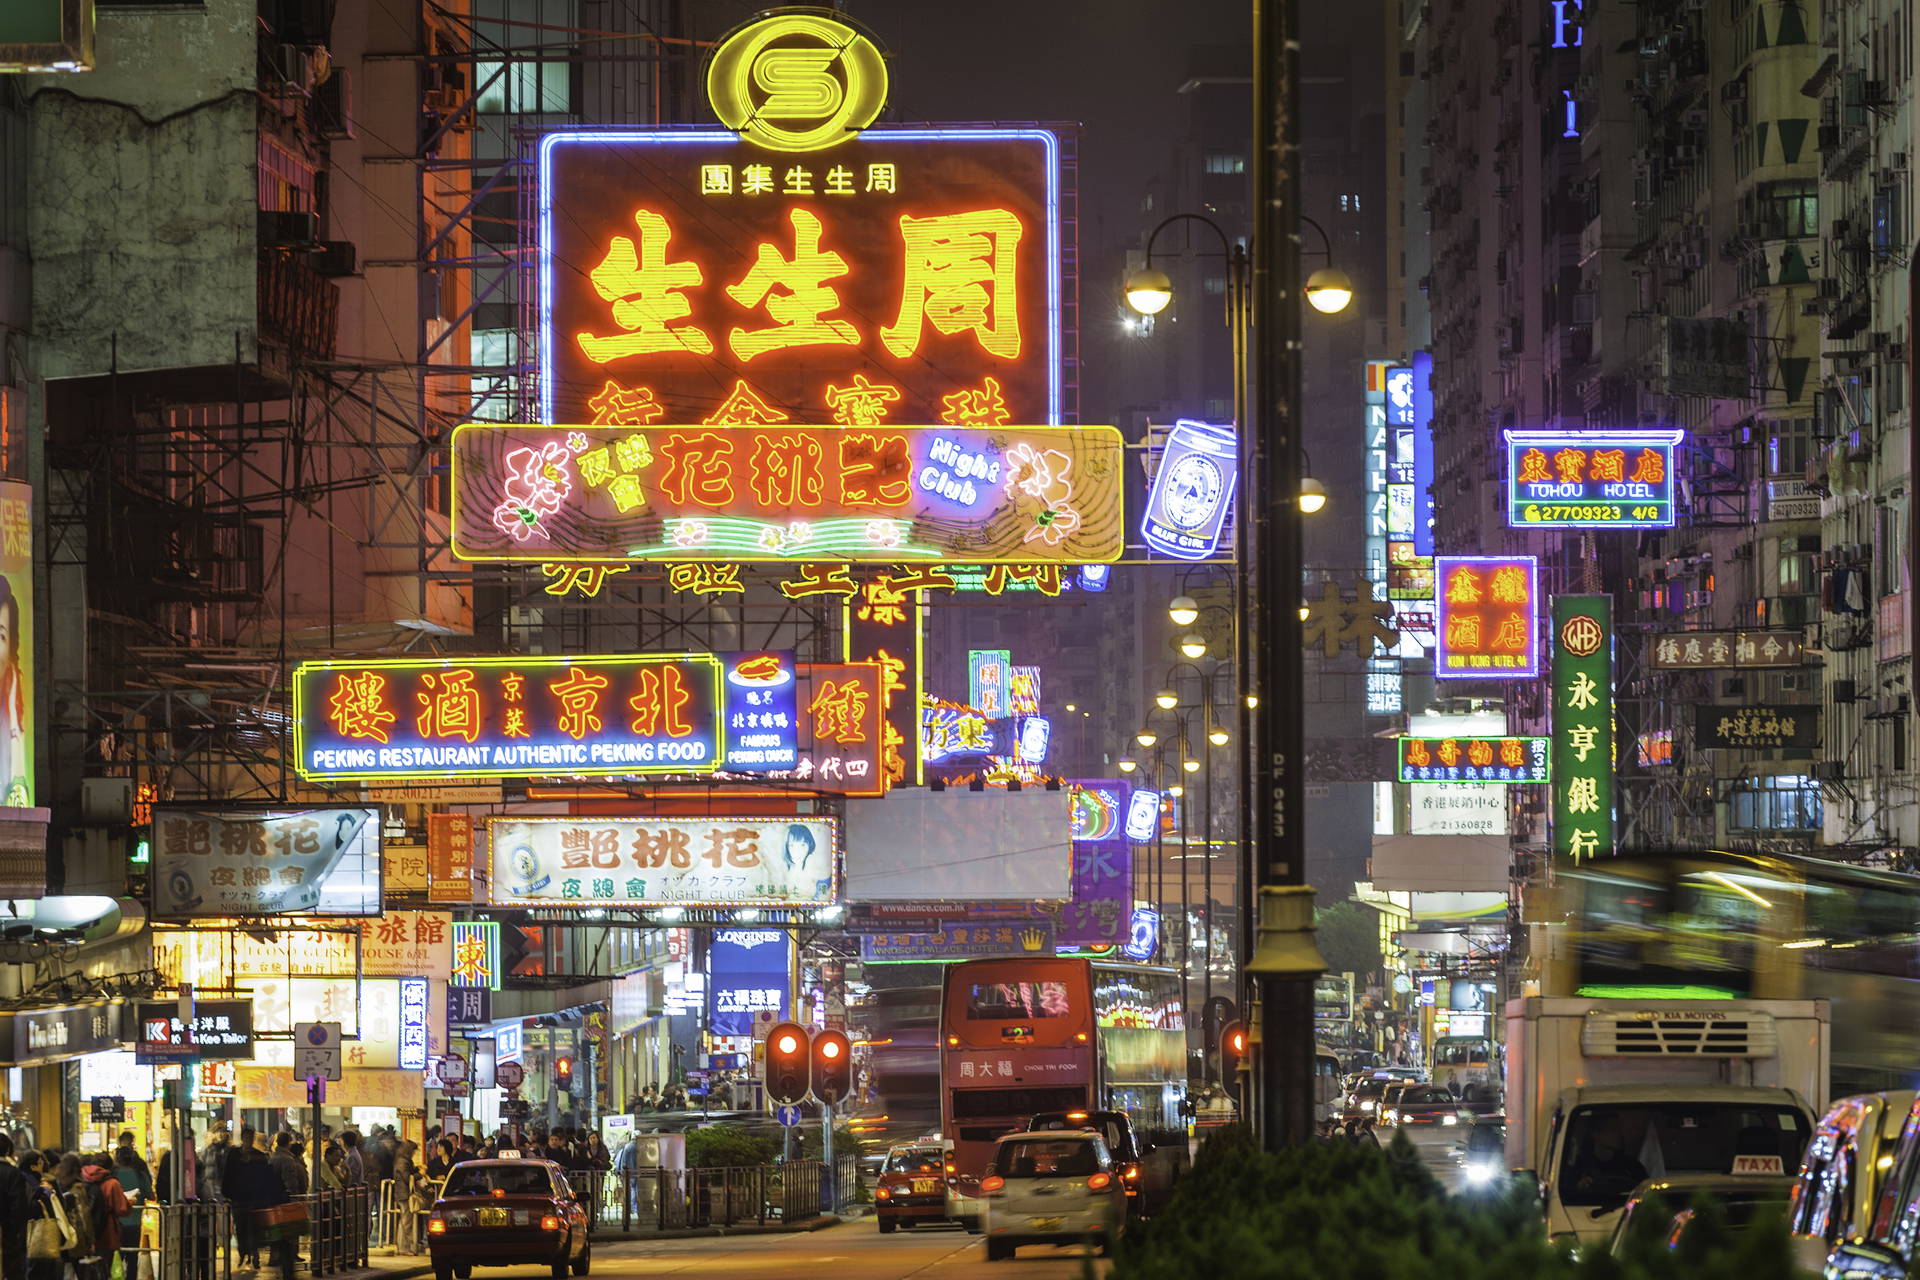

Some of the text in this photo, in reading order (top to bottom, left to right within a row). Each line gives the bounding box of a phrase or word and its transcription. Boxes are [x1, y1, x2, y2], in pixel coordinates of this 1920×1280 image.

[929, 437, 1001, 485] Night
[1518, 448, 1665, 483] 東寶酒店
[919, 466, 978, 506] Club
[1528, 483, 1655, 498] TOHOU HOTEL
[1541, 506, 1622, 520] 27709323
[1152, 525, 1206, 550] BLUE GIRL
[740, 733, 781, 747] FAMOUS
[313, 741, 706, 769] PEKING RESTAURANT AUTHENTIC PEKING FOOD
[1567, 672, 1600, 867] 永亨銀行
[562, 877, 648, 900] 夜總會
[660, 889, 745, 901] NIGHT CLUB
[717, 931, 782, 942] LONGINES
[452, 933, 493, 981] 東
[1684, 1012, 1727, 1020] MOTORS
[199, 1033, 221, 1044] Kee
[221, 1033, 248, 1045] Tailor
[960, 1060, 1014, 1078] 周大福
[1024, 1064, 1044, 1072] CHOW
[1738, 1158, 1780, 1171] TAXI
